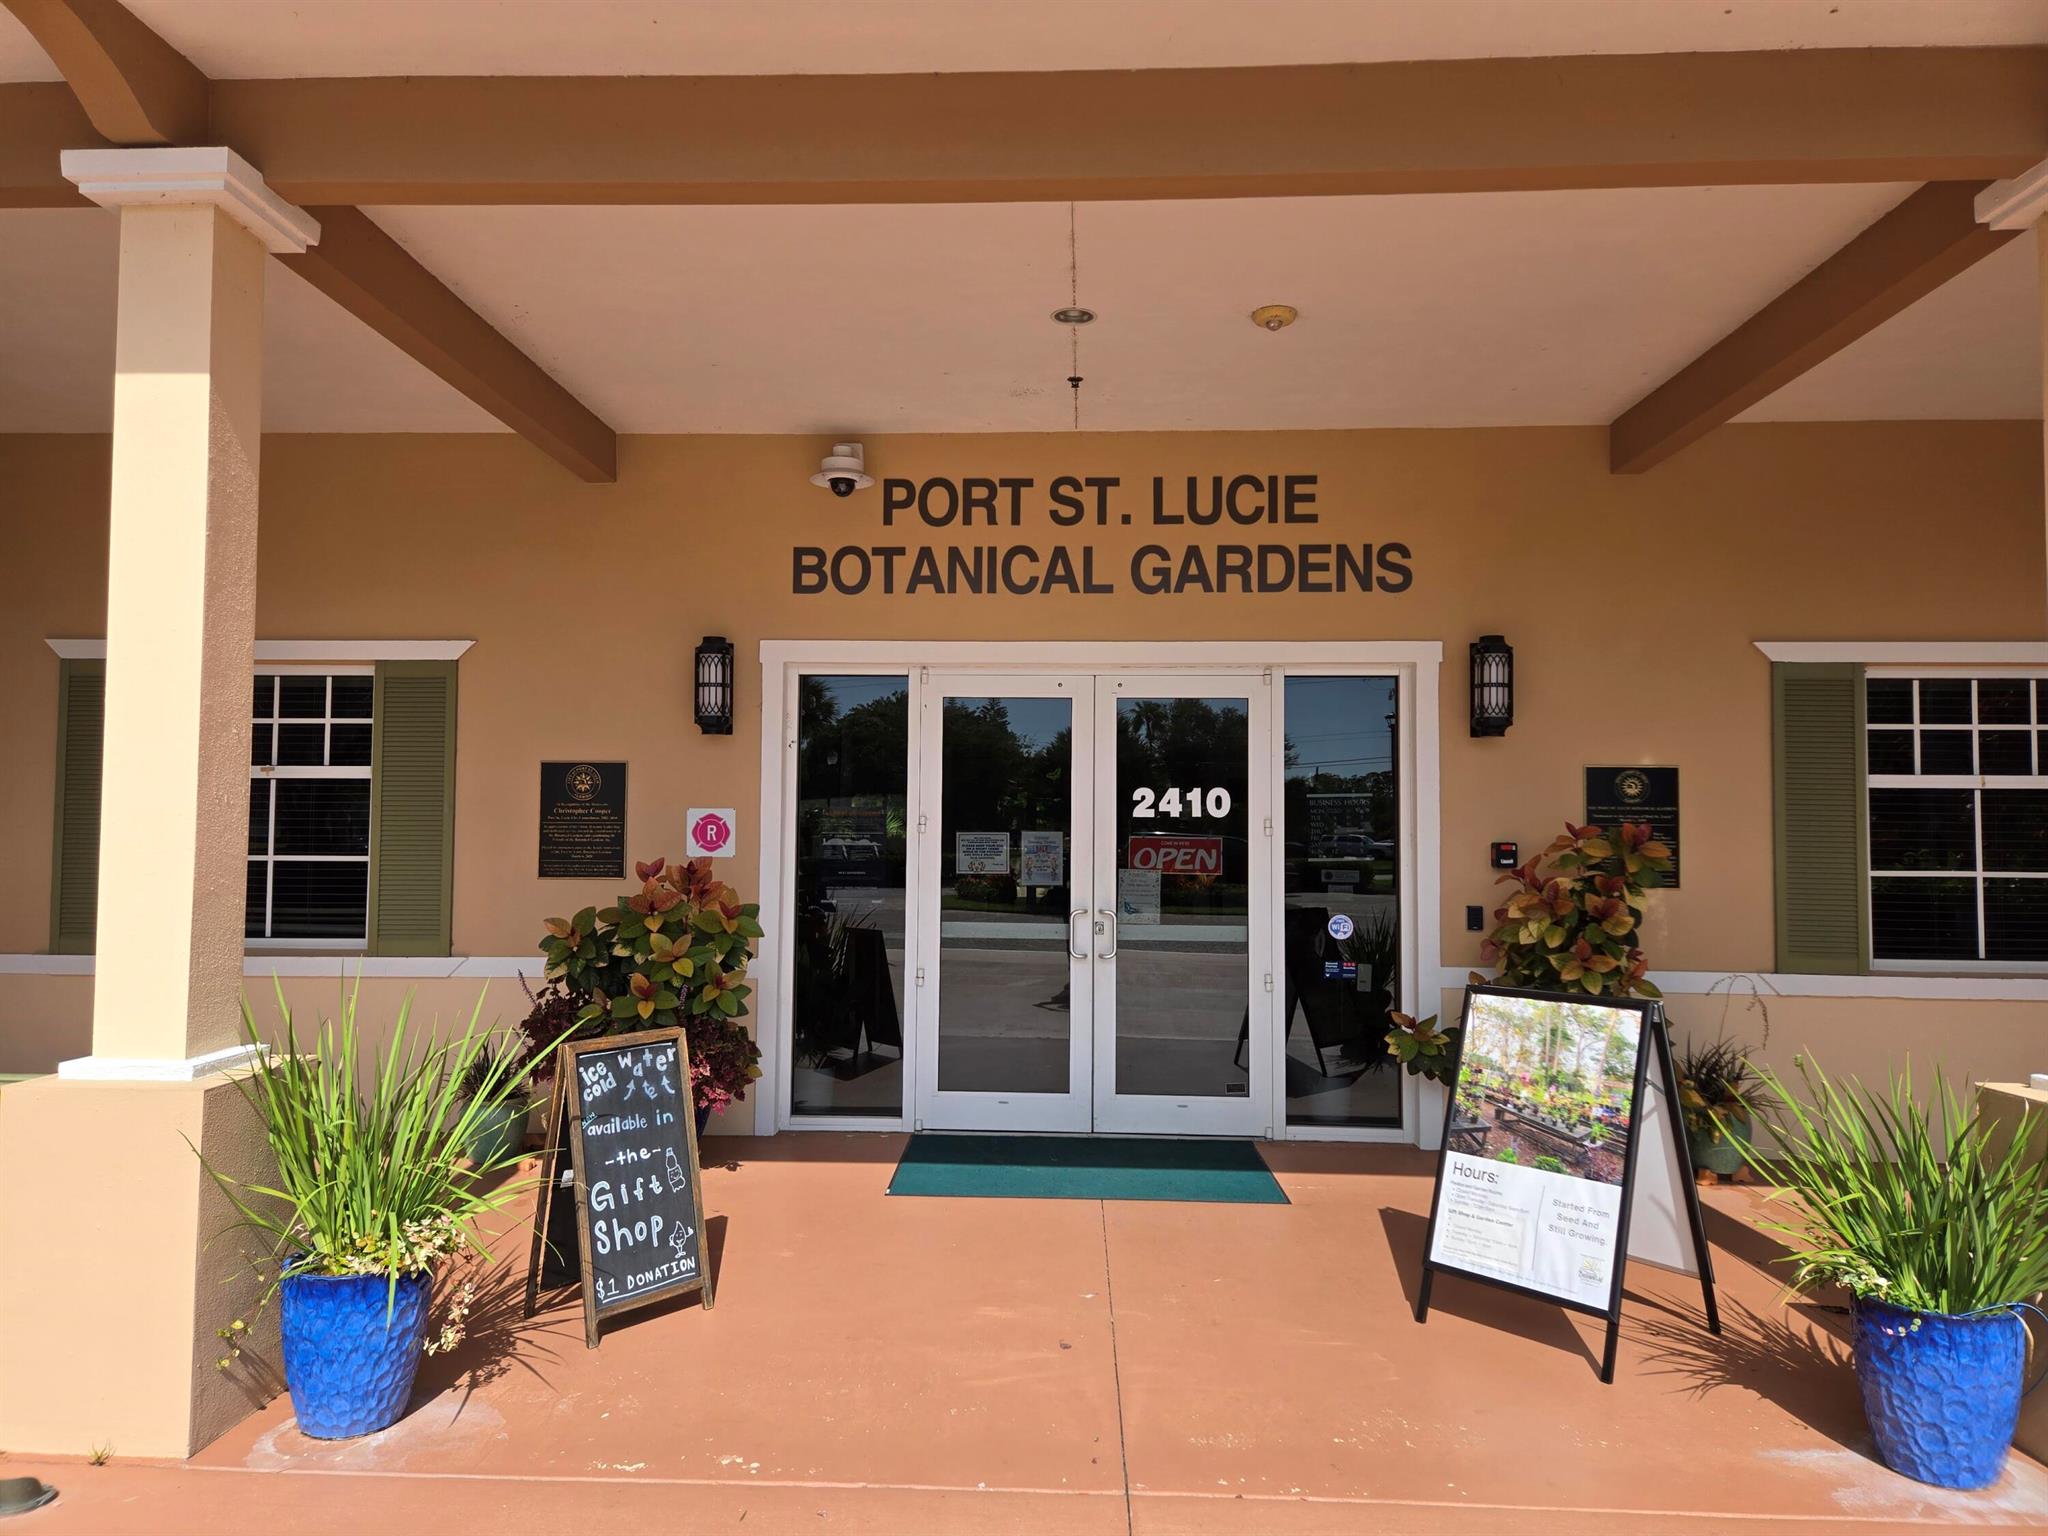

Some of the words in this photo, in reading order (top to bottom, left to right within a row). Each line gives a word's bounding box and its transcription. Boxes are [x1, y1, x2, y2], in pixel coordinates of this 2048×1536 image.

[883, 477, 1034, 527] PORT
[1049, 476, 1132, 526] ST.
[1153, 475, 1319, 525] LUCIE
[792, 545, 1114, 595] BOTANICAL
[1131, 542, 1414, 595] GARDENS
[1132, 787, 1231, 818] 2410
[707, 825, 717, 841] R
[1133, 847, 1217, 870] OPEN
[583, 1071, 617, 1101] cold
[587, 1113, 648, 1136] available
[655, 1109, 673, 1126] in
[1452, 1161, 1500, 1184] Hours:
[591, 1174, 663, 1212] Gift
[1552, 1198, 1585, 1213] Started
[1587, 1206, 1610, 1219] From
[1556, 1212, 1580, 1225] Seed
[1581, 1218, 1599, 1230] And
[594, 1215, 663, 1255] Shop
[1548, 1223, 1566, 1235] Still
[596, 1277, 620, 1300] $1
[627, 1256, 696, 1290] DONATION
